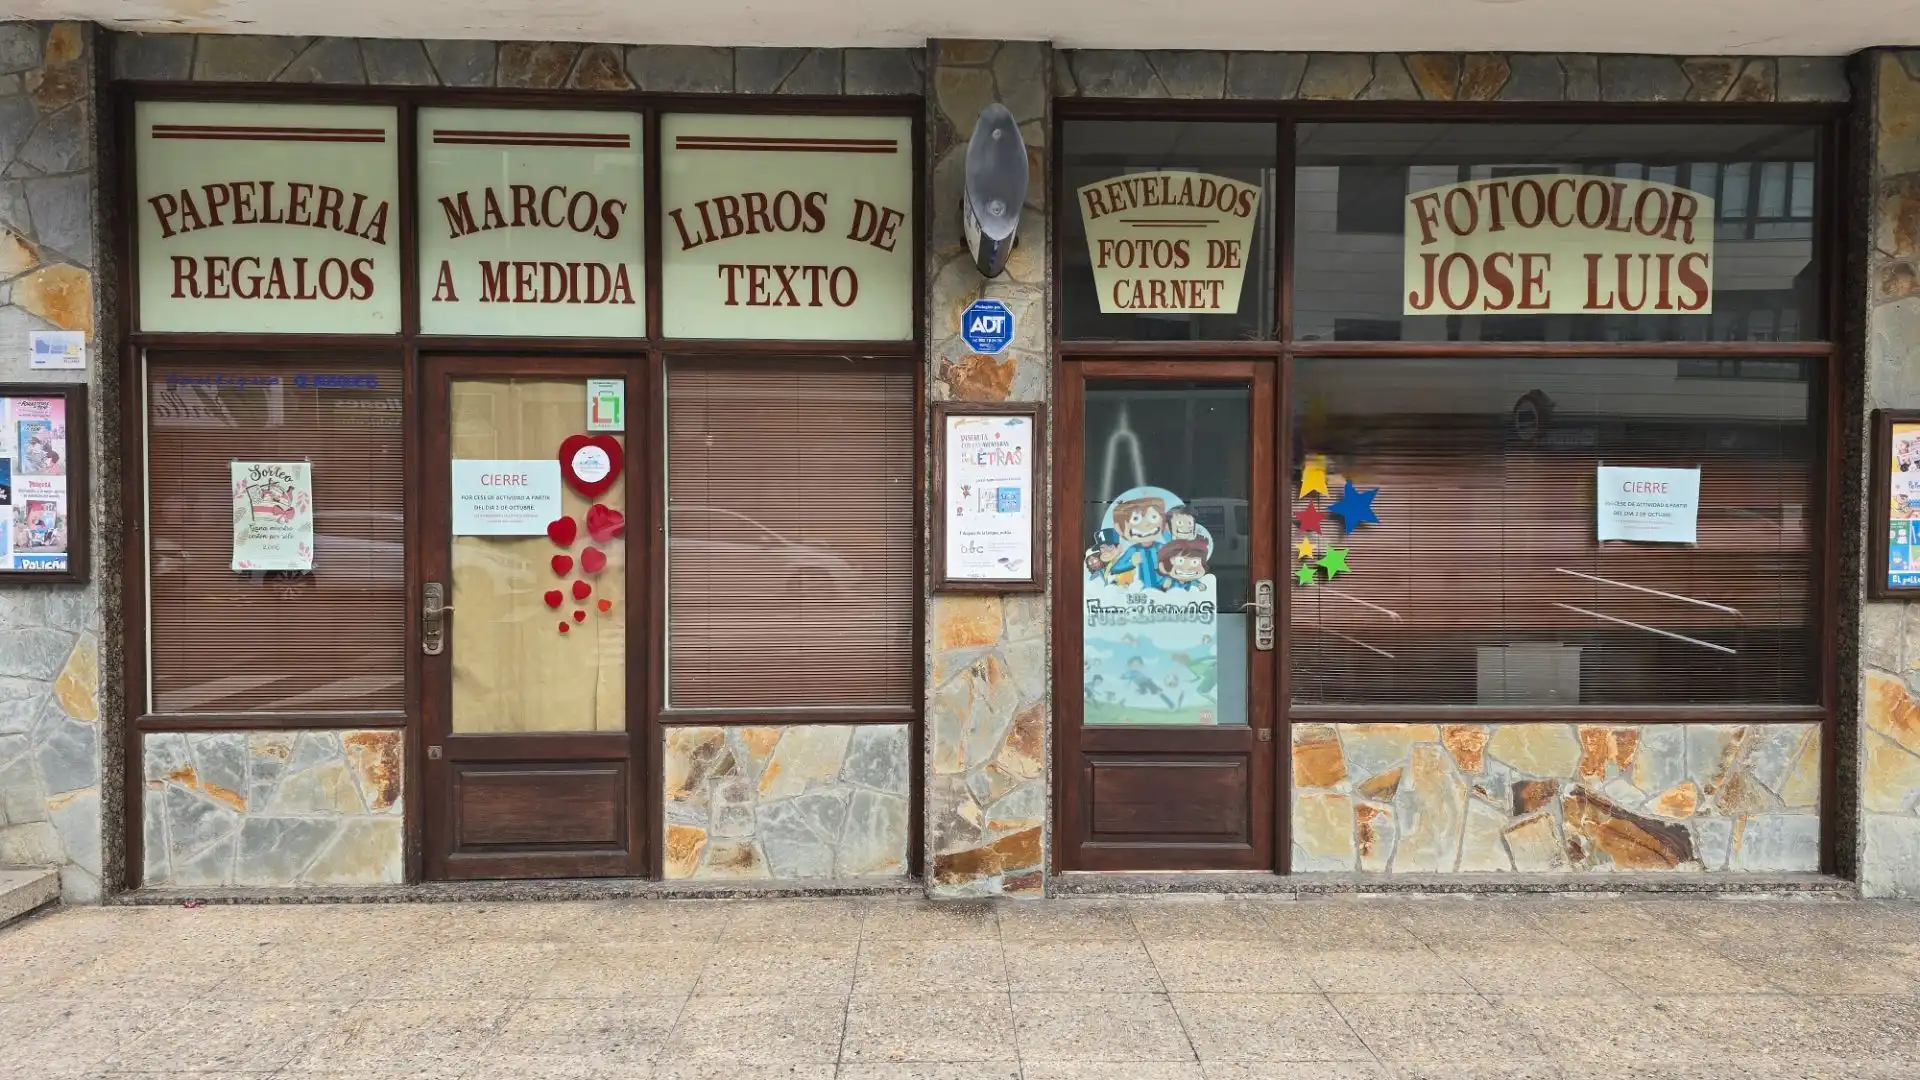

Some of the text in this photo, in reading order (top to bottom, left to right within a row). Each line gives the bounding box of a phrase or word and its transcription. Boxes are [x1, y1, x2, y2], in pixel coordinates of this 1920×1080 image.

[148, 181, 389, 245] PAPELERIA
[438, 184, 627, 240] MARCOS
[1082, 176, 1257, 220] REVELADOS
[1410, 178, 1699, 246] FOTOCOLOR
[668, 190, 828, 251] LIBROS
[847, 198, 905, 253] DE
[1097, 239, 1242, 270] FOTOS DE
[171, 255, 375, 301] REGALOS
[431, 260, 636, 304] A MEDIDA
[718, 264, 858, 307] TEXTO
[1112, 279, 1225, 309] CARNET
[1408, 252, 1709, 311] JOSE LUIS
[970, 315, 1005, 334] ADT
[248, 464, 294, 482] Sorteo
[481, 474, 528, 486] CIERRE
[1623, 481, 1669, 493] CIERRE
